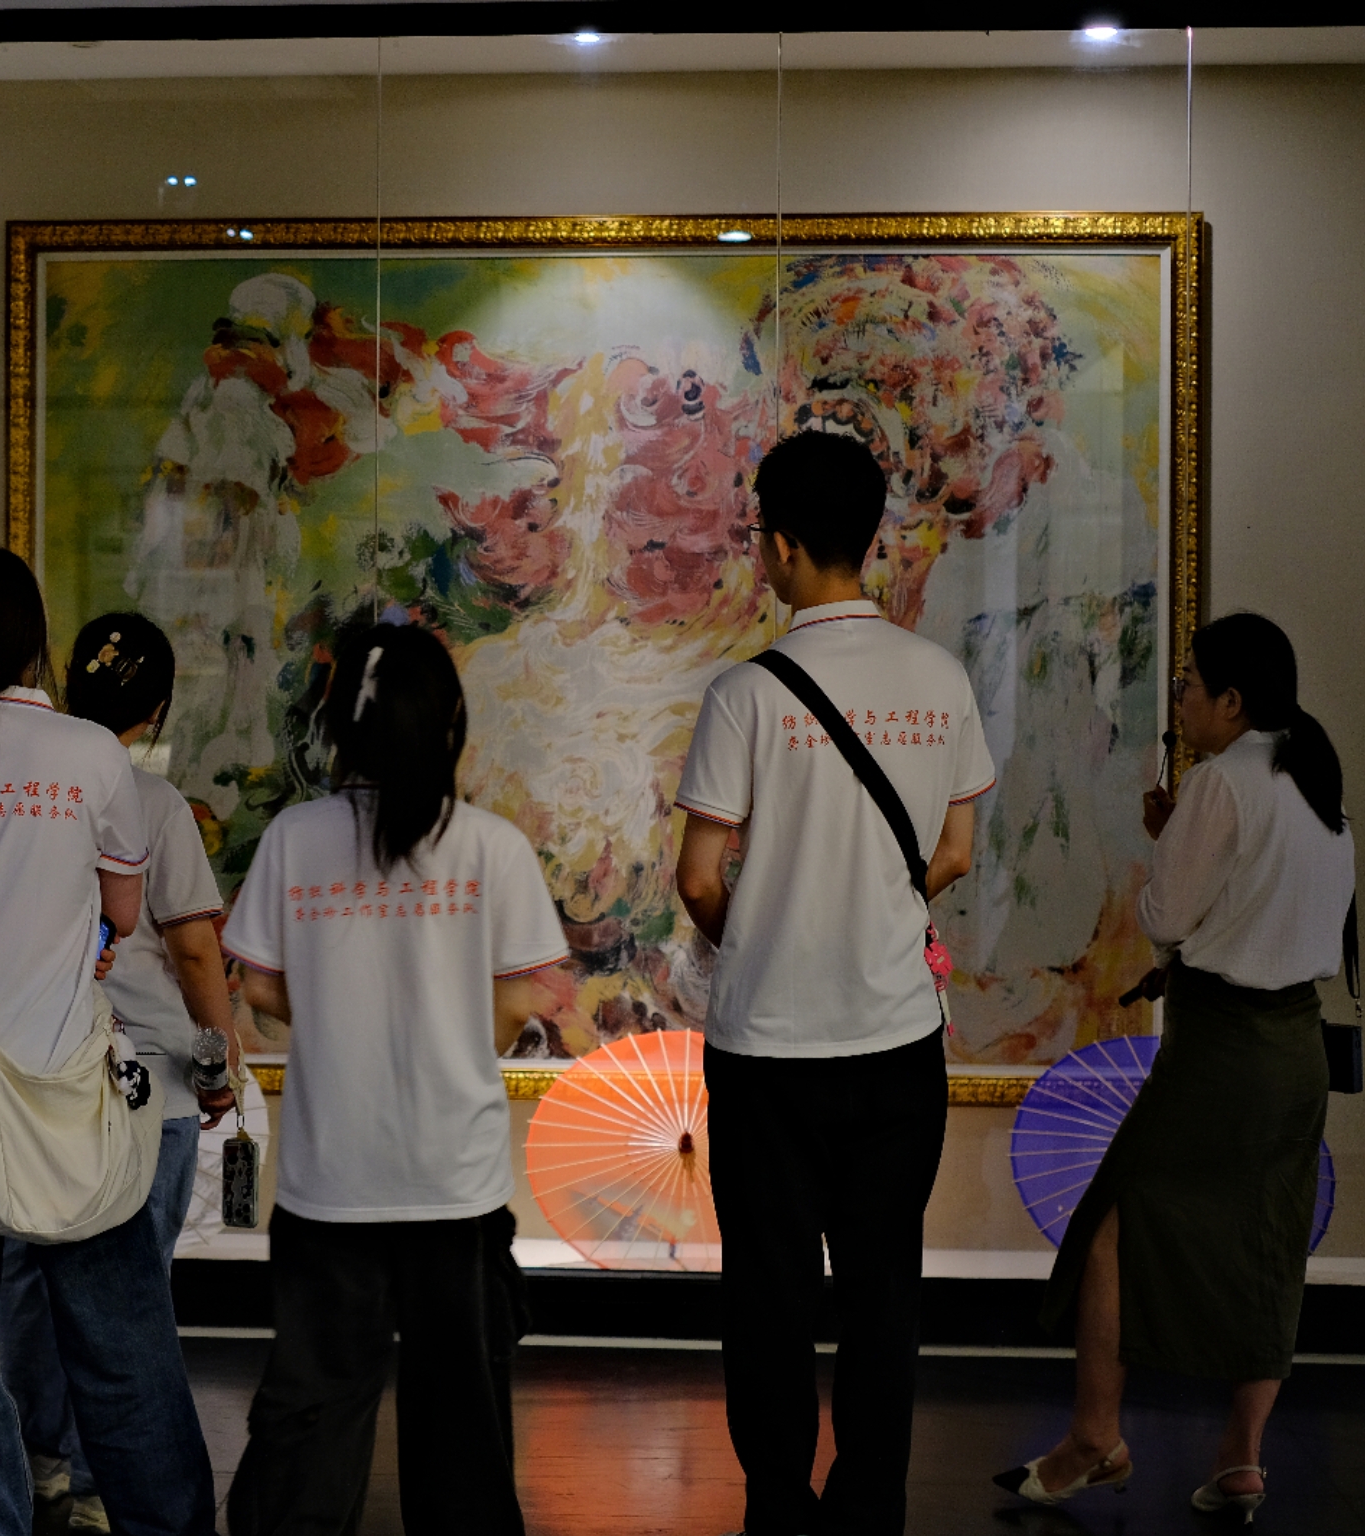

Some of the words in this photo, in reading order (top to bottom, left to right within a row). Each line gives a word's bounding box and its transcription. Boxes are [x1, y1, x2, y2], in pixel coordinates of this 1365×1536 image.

[781, 709, 951, 731] 纺织学与工程学院
